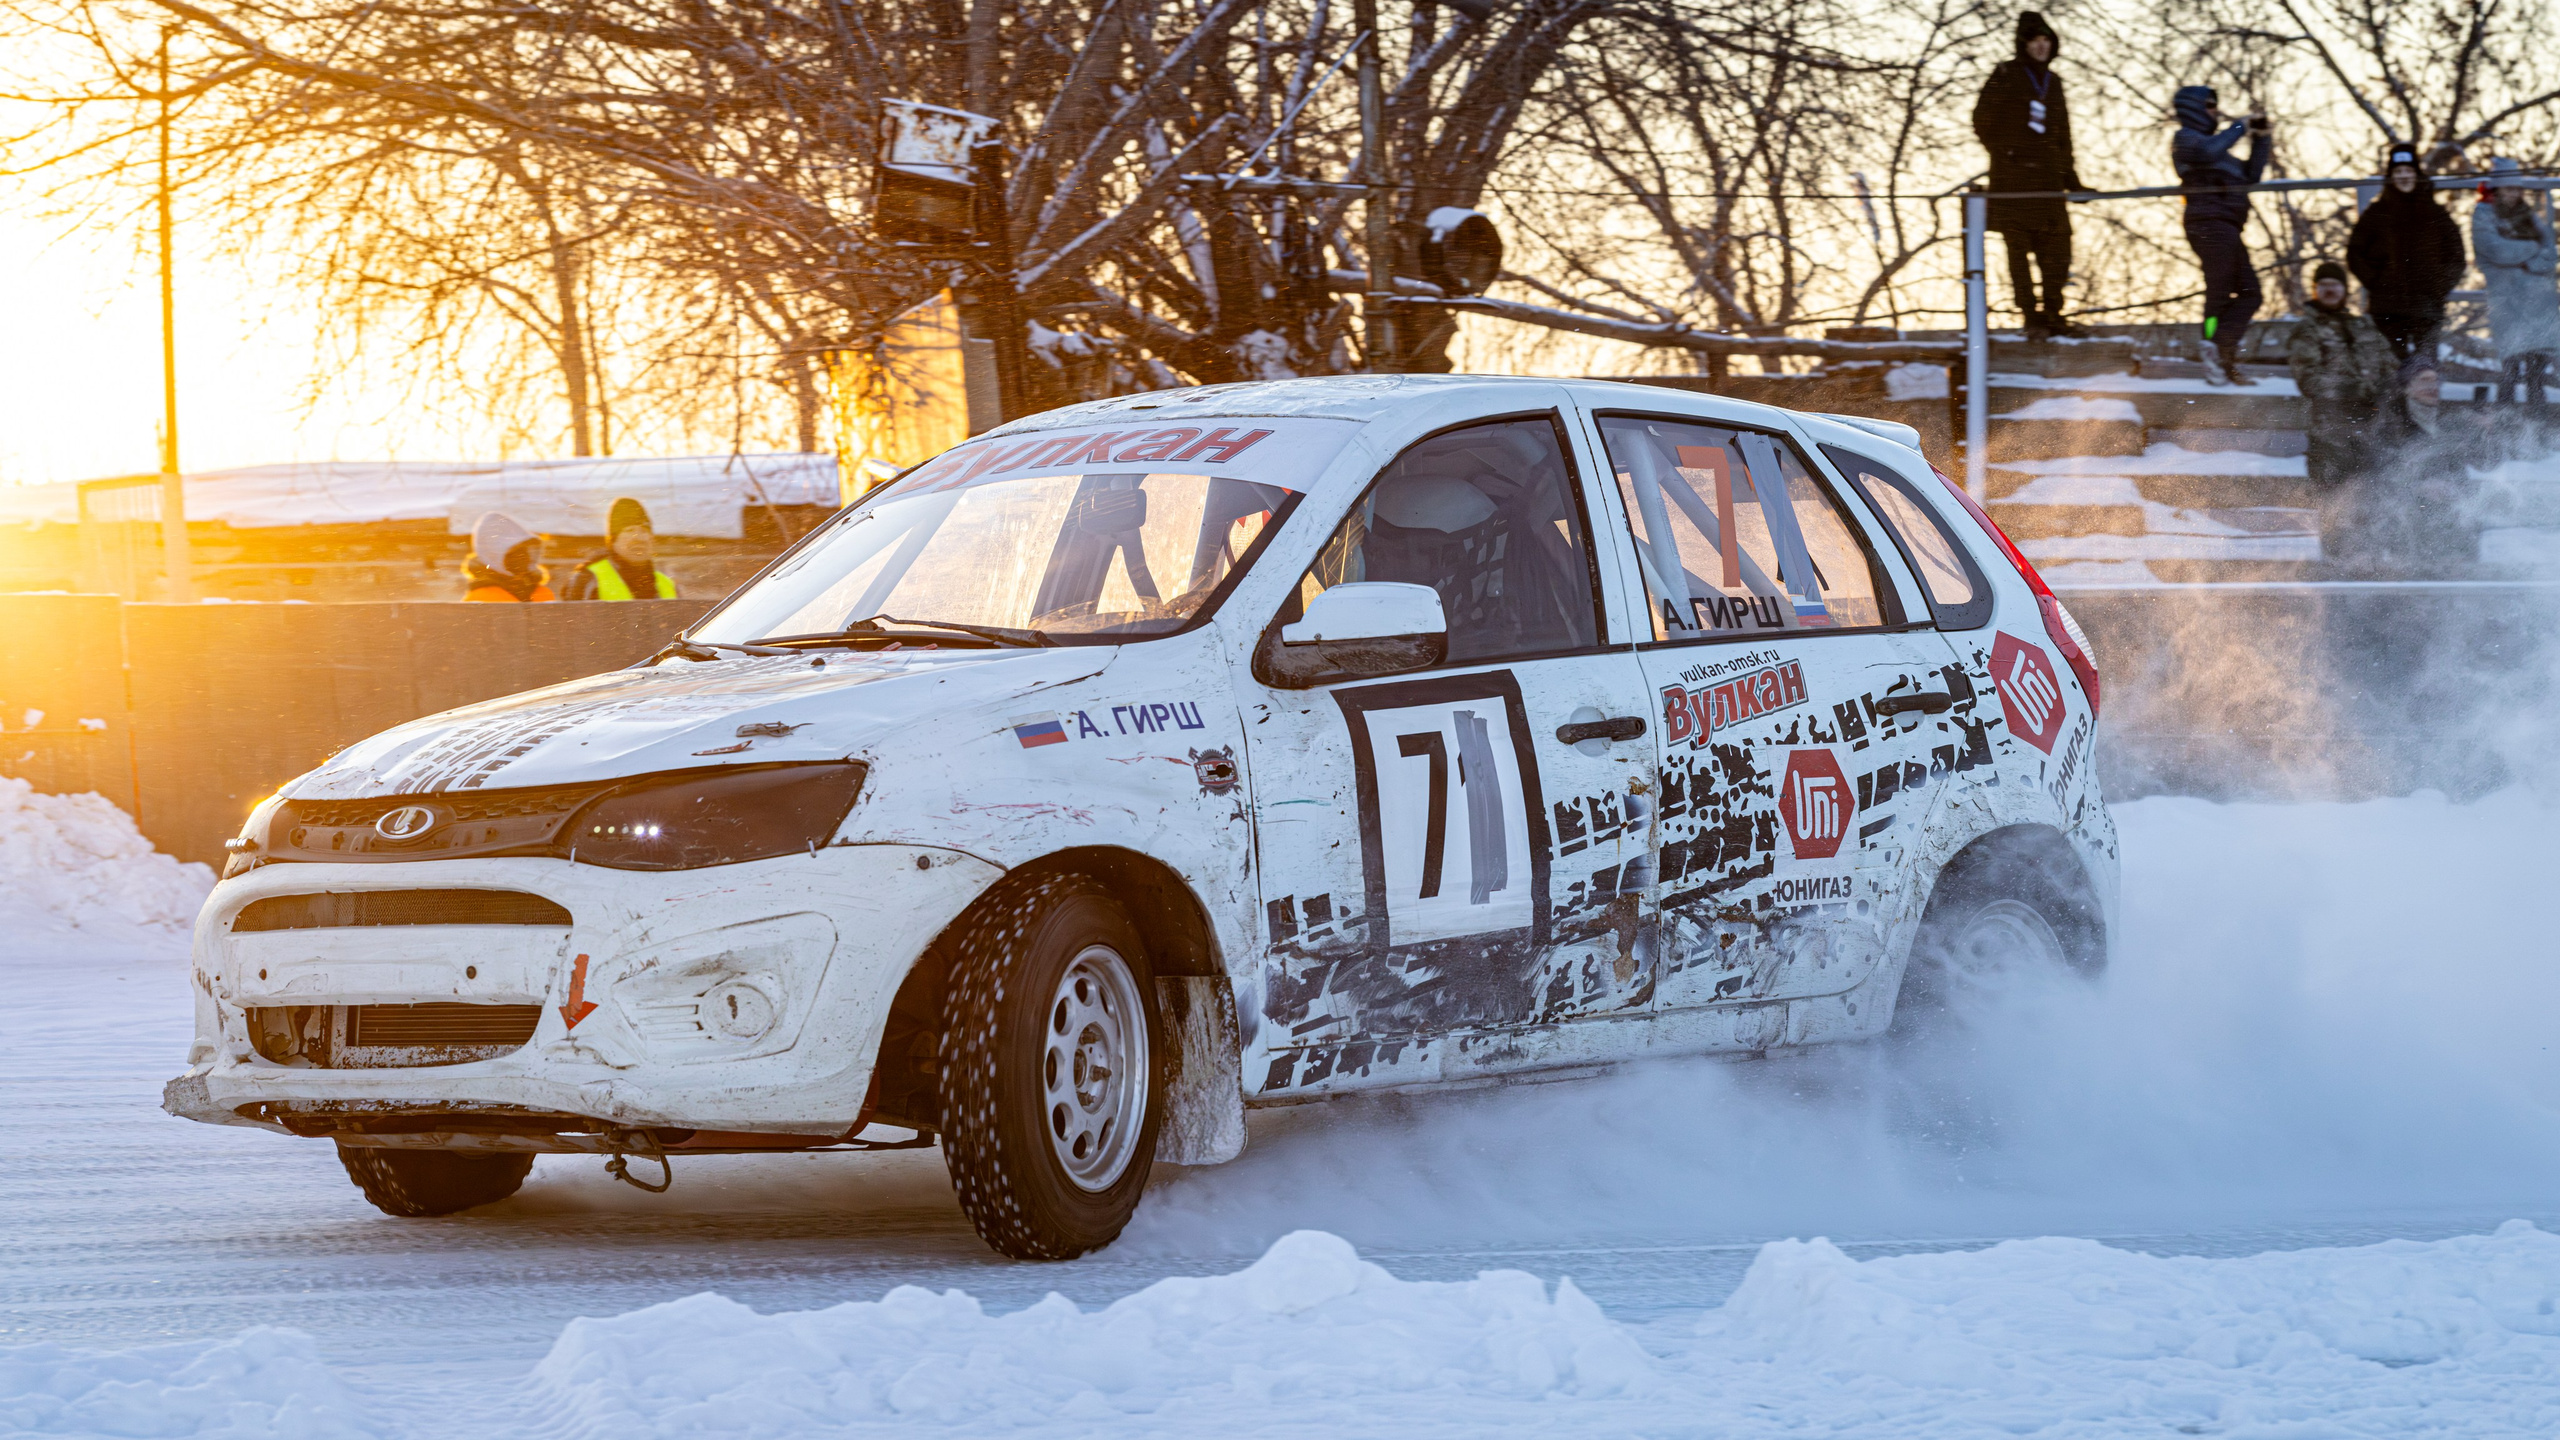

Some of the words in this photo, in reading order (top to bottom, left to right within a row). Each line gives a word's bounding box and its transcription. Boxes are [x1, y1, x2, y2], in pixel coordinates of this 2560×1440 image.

[1679, 648, 1781, 684] vulkan-omsk.ru
[1111, 701, 1206, 735] ГИРШ
[1660, 658, 1809, 749] Вулкан
[1776, 875, 1853, 903] ЮНИГАЗ
